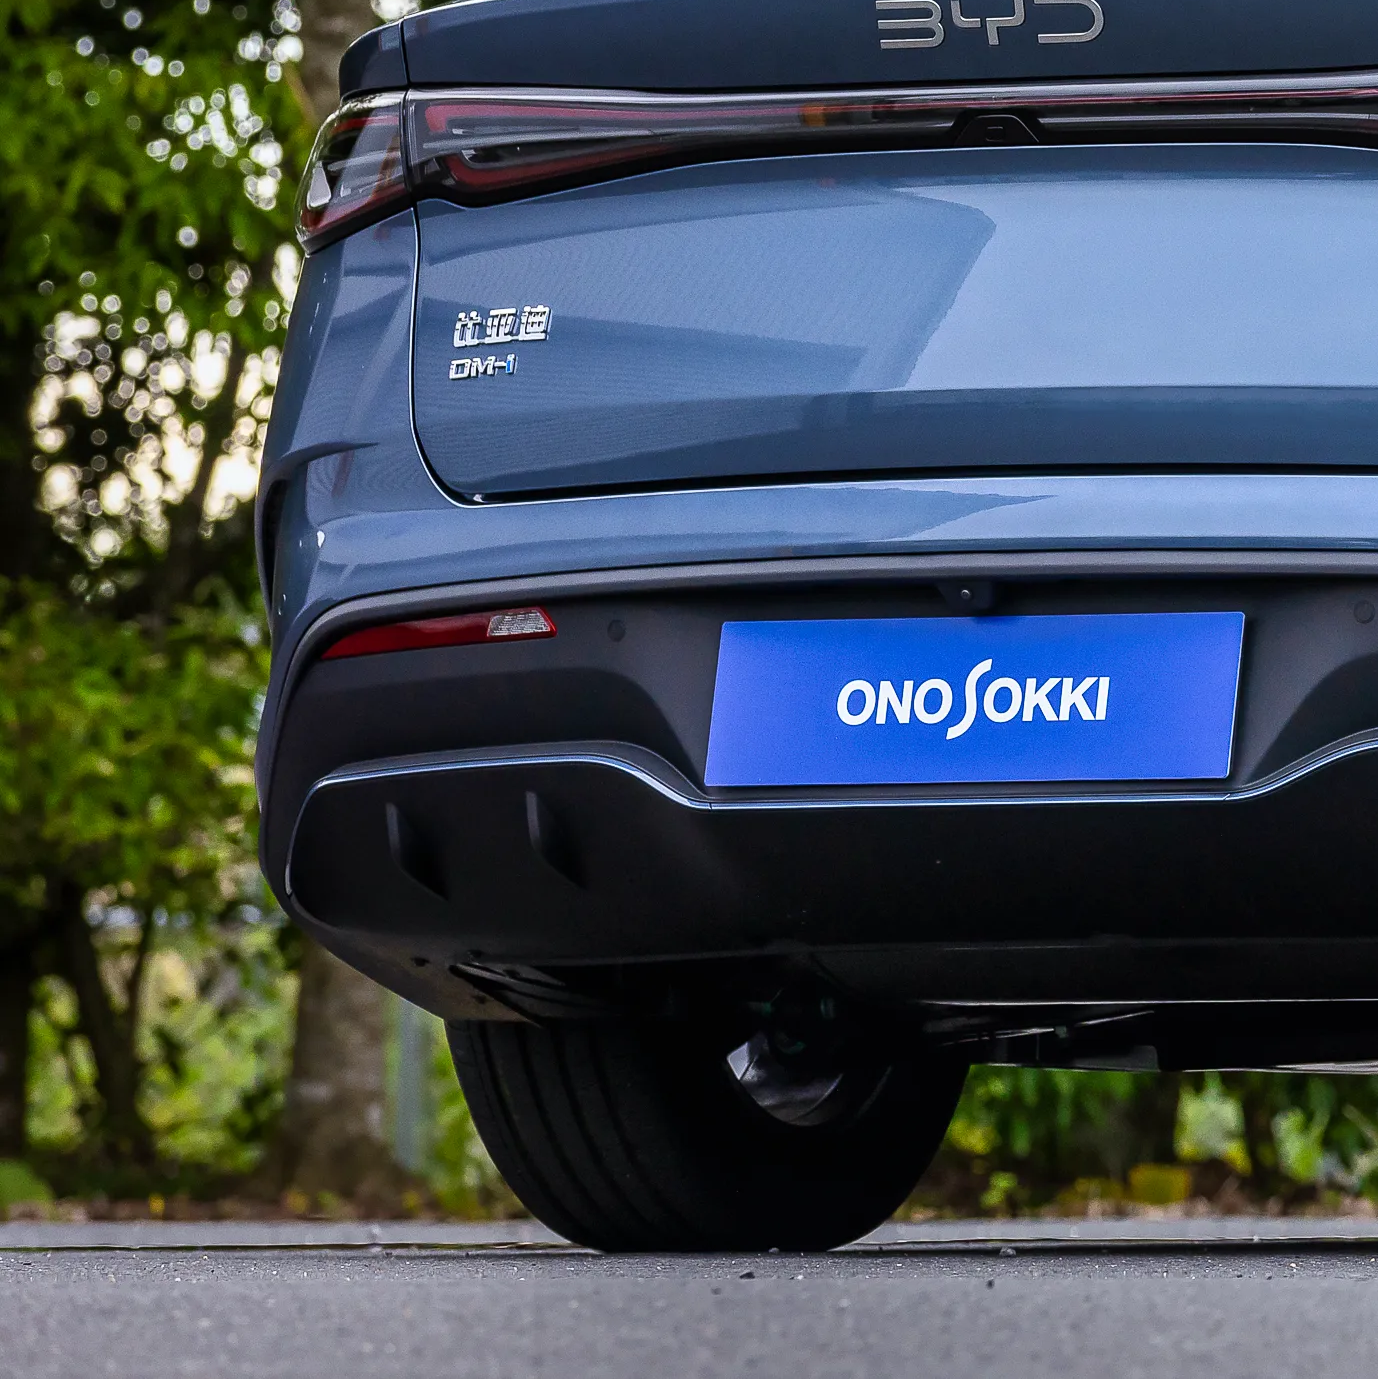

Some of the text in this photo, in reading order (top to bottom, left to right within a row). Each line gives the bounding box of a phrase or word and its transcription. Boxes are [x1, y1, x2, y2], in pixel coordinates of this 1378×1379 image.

[453, 304, 551, 348] 比亚迪
[449, 353, 517, 380] DM-i
